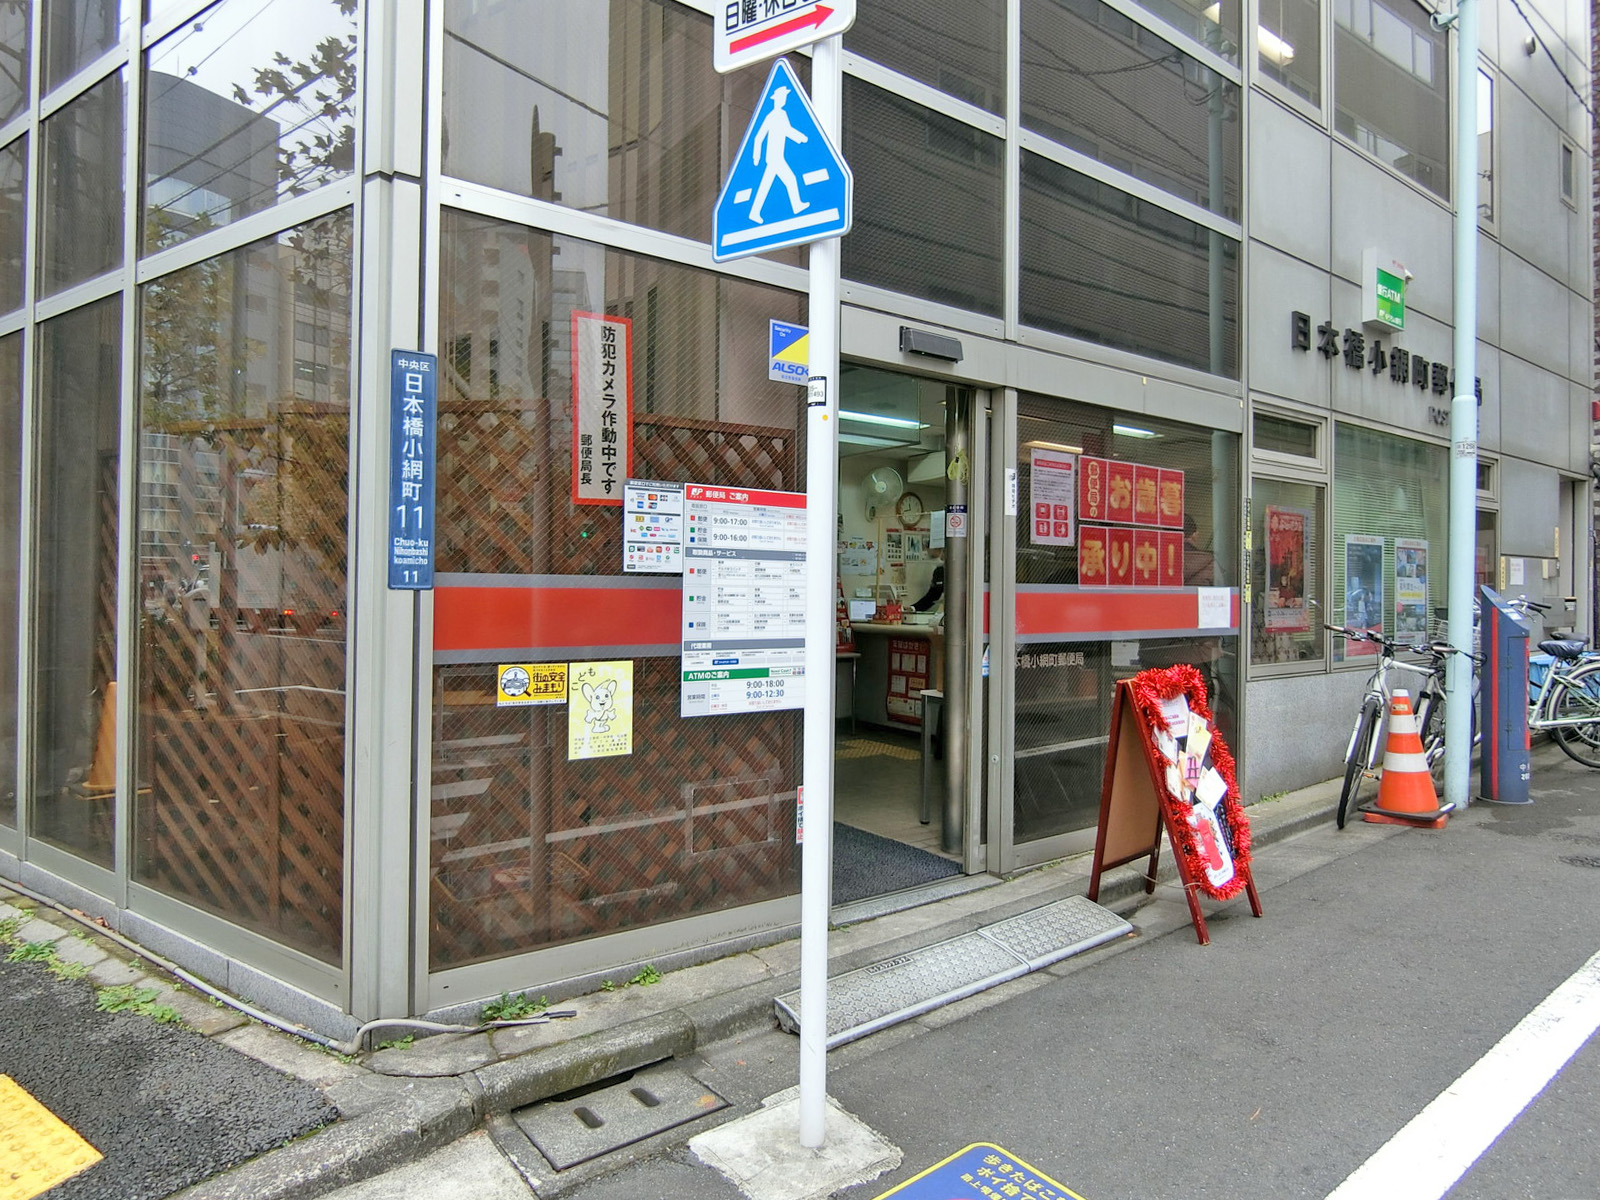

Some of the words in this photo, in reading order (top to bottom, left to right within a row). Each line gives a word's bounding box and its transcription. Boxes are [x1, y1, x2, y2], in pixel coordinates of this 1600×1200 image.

[398, 358, 431, 372] 中央区
[1291, 310, 1482, 407] 日本橋小網町郵
[601, 325, 617, 495] 防犯カメラ作動中です
[1428, 406, 1450, 427] POS
[402, 373, 425, 502] 日本橋小網町
[580, 433, 593, 485] 郵便局長
[705, 490, 726, 499] 郵便局
[396, 504, 423, 529] 11
[713, 517, 748, 526] 9:00-17:00
[394, 537, 429, 547] Chuo-ku
[713, 533, 748, 542] 9:00-16:00
[394, 556, 429, 565] koamicho
[403, 570, 418, 583] 11
[571, 667, 596, 691] こども
[746, 679, 785, 689] 9:00-18:00
[746, 689, 785, 699] 9:00-12:30
[961, 1173, 1006, 1200] 路上喫煙
